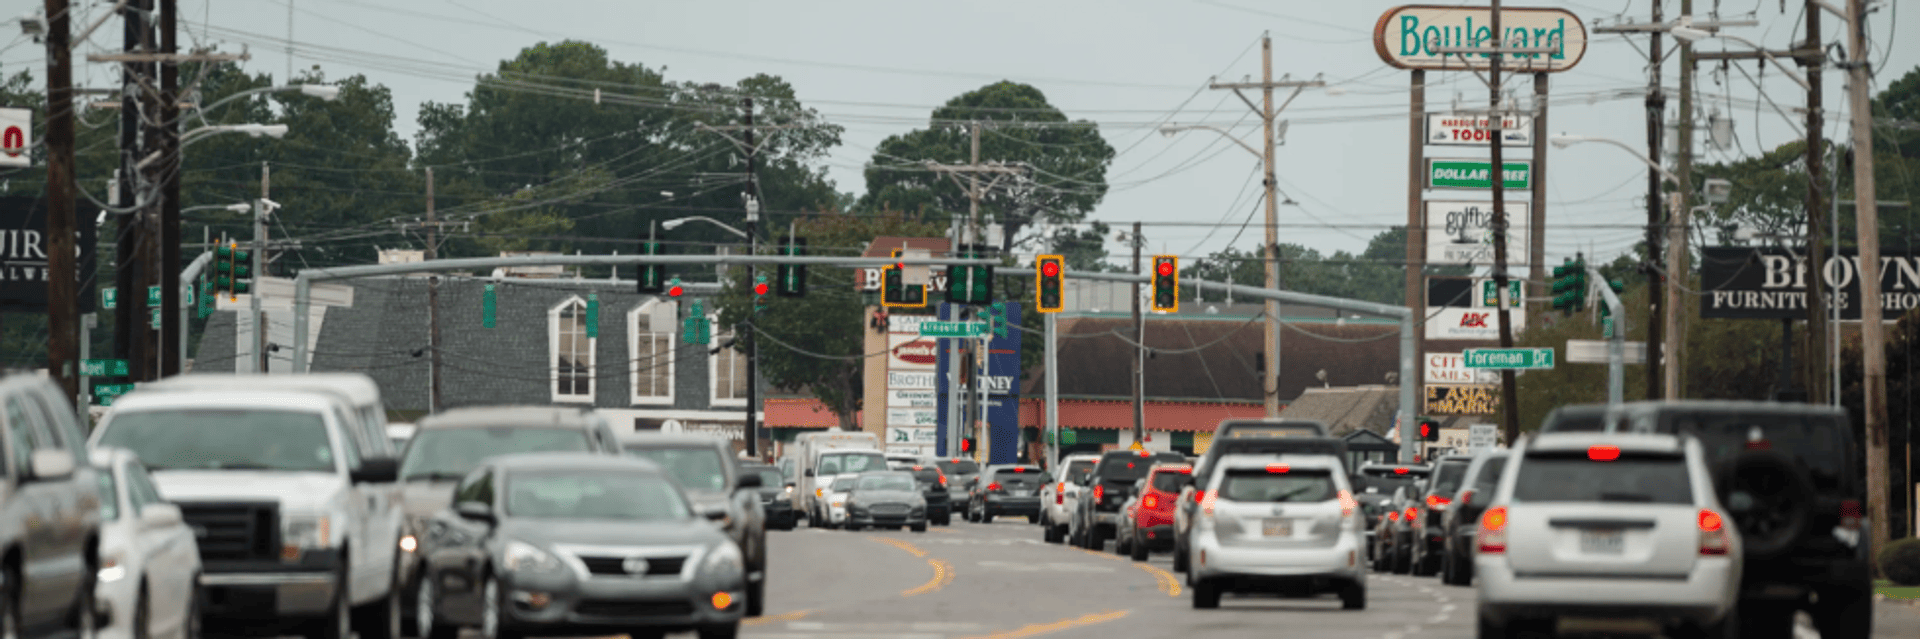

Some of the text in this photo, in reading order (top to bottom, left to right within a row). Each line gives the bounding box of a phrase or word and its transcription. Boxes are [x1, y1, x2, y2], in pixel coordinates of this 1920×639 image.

[1479, 119, 1514, 128] FRHT
[1452, 129, 1493, 141] TOOL
[1433, 168, 1528, 181] DOLLAR REE
[1445, 206, 1511, 236] golfbas
[1430, 355, 1465, 368] CIT
[1468, 350, 1549, 365] Foreman Dr
[890, 373, 936, 386] BROTH
[946, 372, 1014, 390] TNEY
[1430, 371, 1471, 380] NAILS
[1437, 399, 1498, 414] MARK
